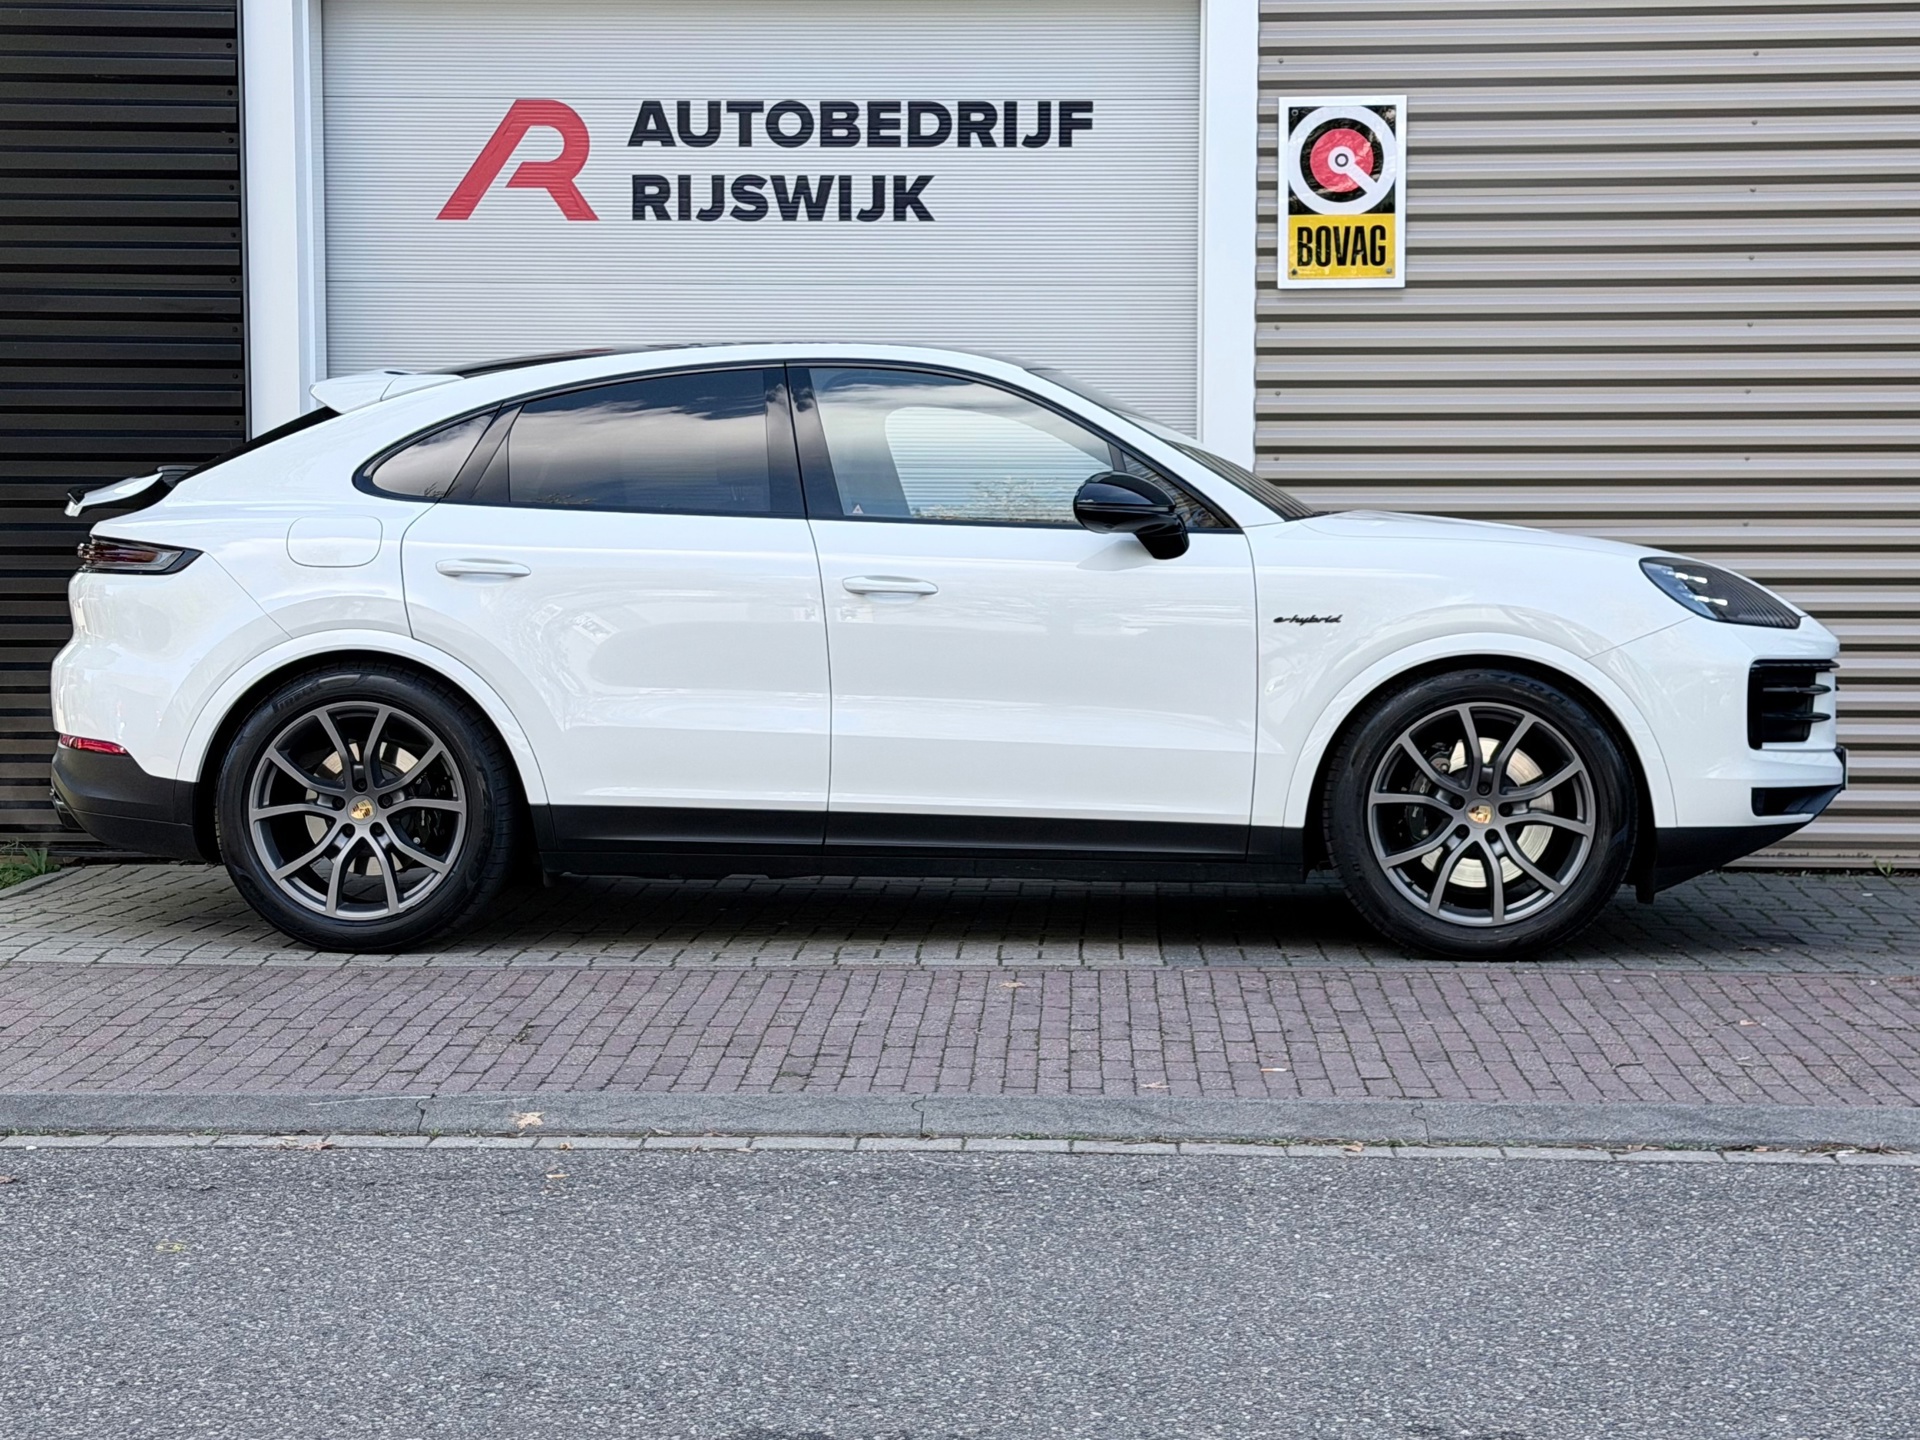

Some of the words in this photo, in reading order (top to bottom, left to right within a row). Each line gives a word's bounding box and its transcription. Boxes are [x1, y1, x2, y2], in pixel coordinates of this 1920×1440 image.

[627, 99, 1094, 149] AUTOBEDRIJF
[631, 174, 935, 223] RIJSWIJK
[1297, 225, 1387, 267] BOVAG
[1273, 614, 1343, 626] e-hybrid
